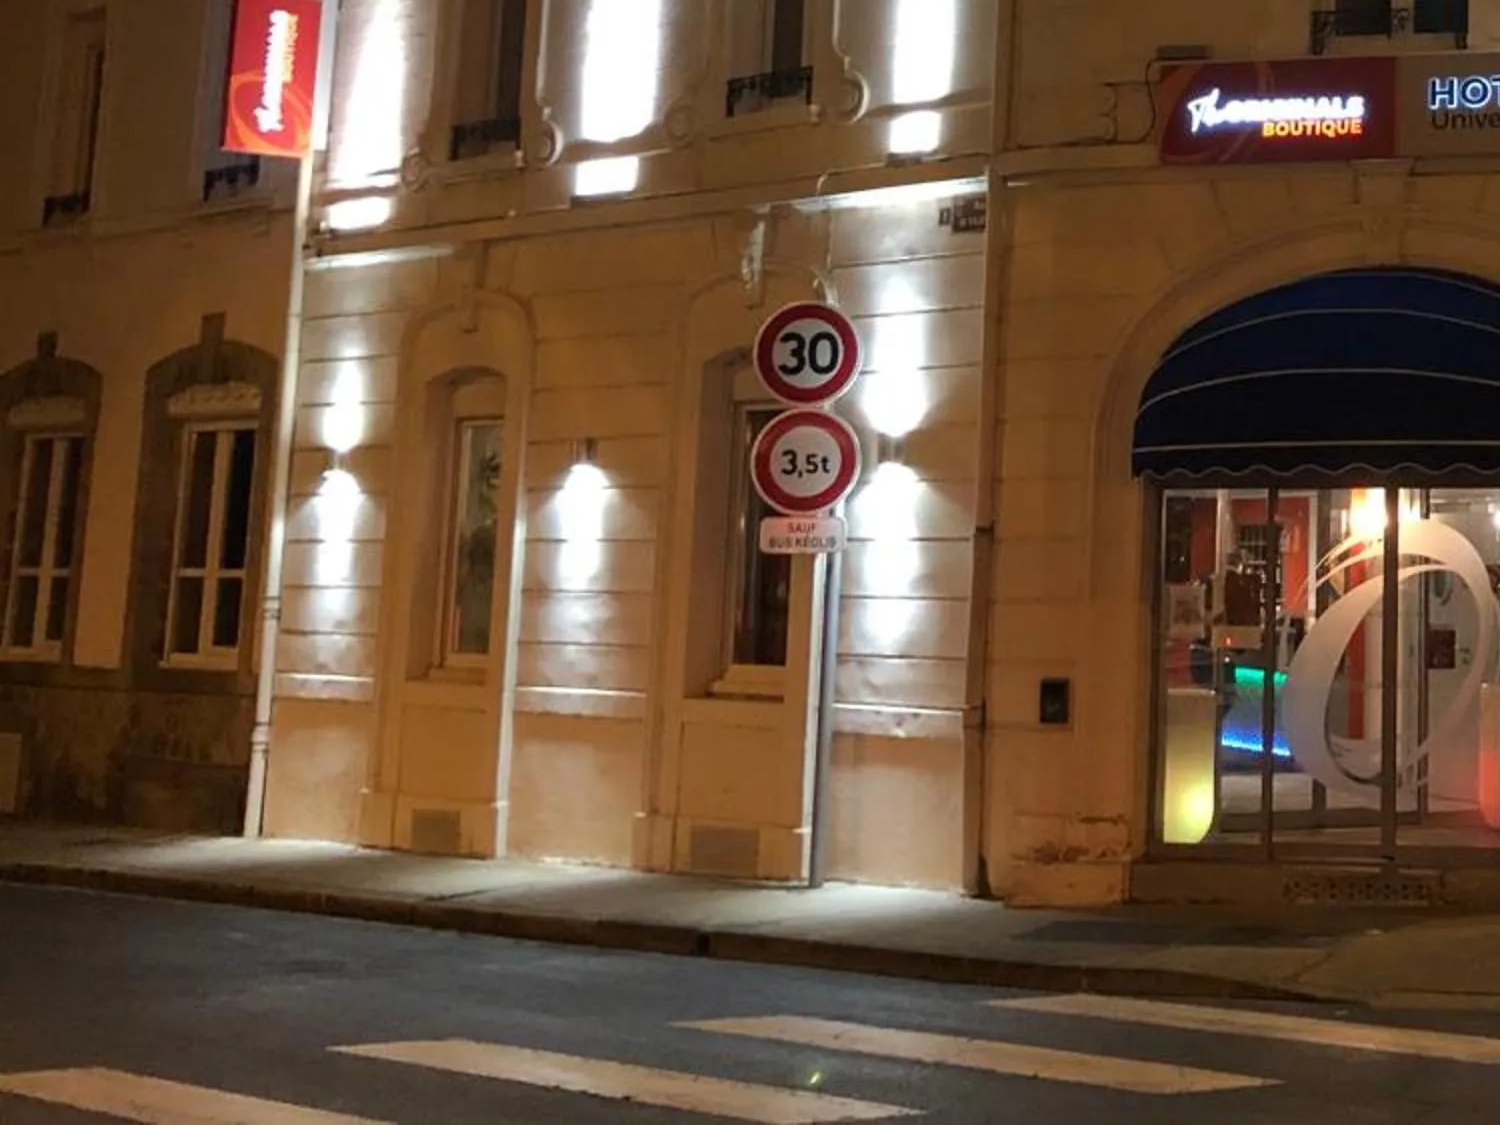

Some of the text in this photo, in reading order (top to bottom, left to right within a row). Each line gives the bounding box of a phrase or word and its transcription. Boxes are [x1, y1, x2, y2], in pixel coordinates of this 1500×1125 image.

[1262, 119, 1362, 138] BOUTIQUE
[778, 331, 839, 375] 30
[780, 448, 831, 478] 3,5t
